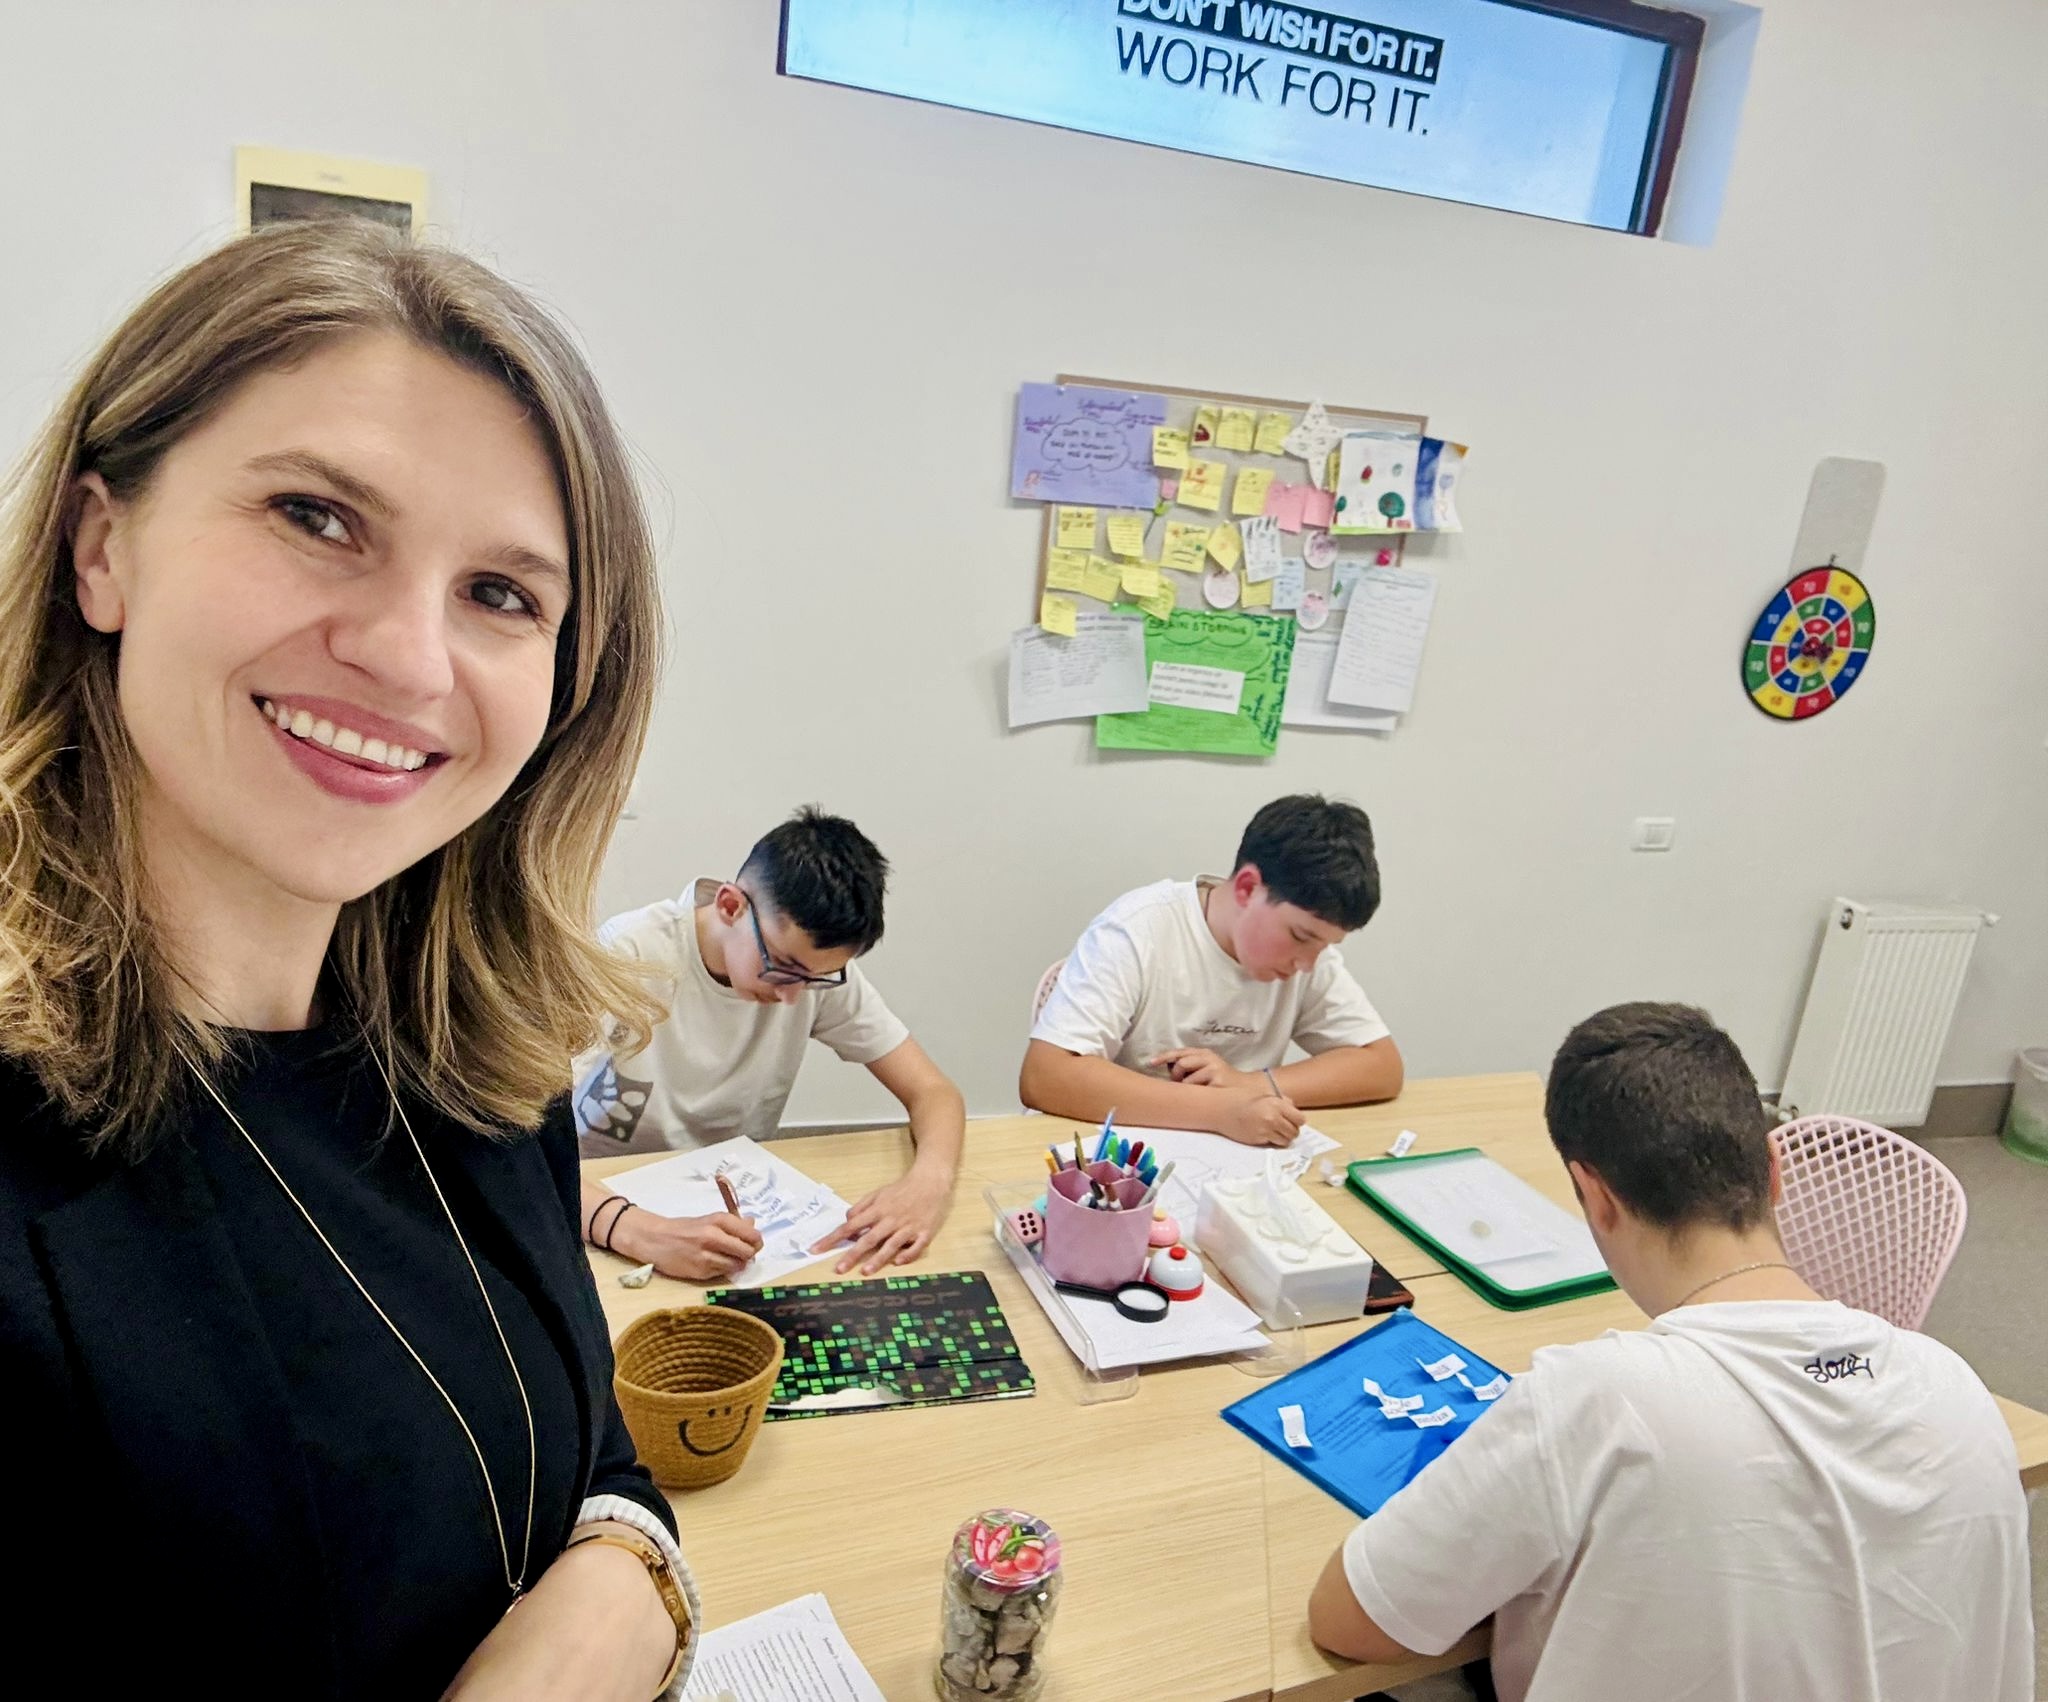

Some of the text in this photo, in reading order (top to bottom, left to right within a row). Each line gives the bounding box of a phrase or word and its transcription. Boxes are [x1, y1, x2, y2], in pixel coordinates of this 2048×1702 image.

[1116, 26, 1431, 136] WORK FOR IT.
[1240, 1, 1329, 54] WISH
[1328, 22, 1400, 70] FOR
[1400, 38, 1436, 78] IT.
